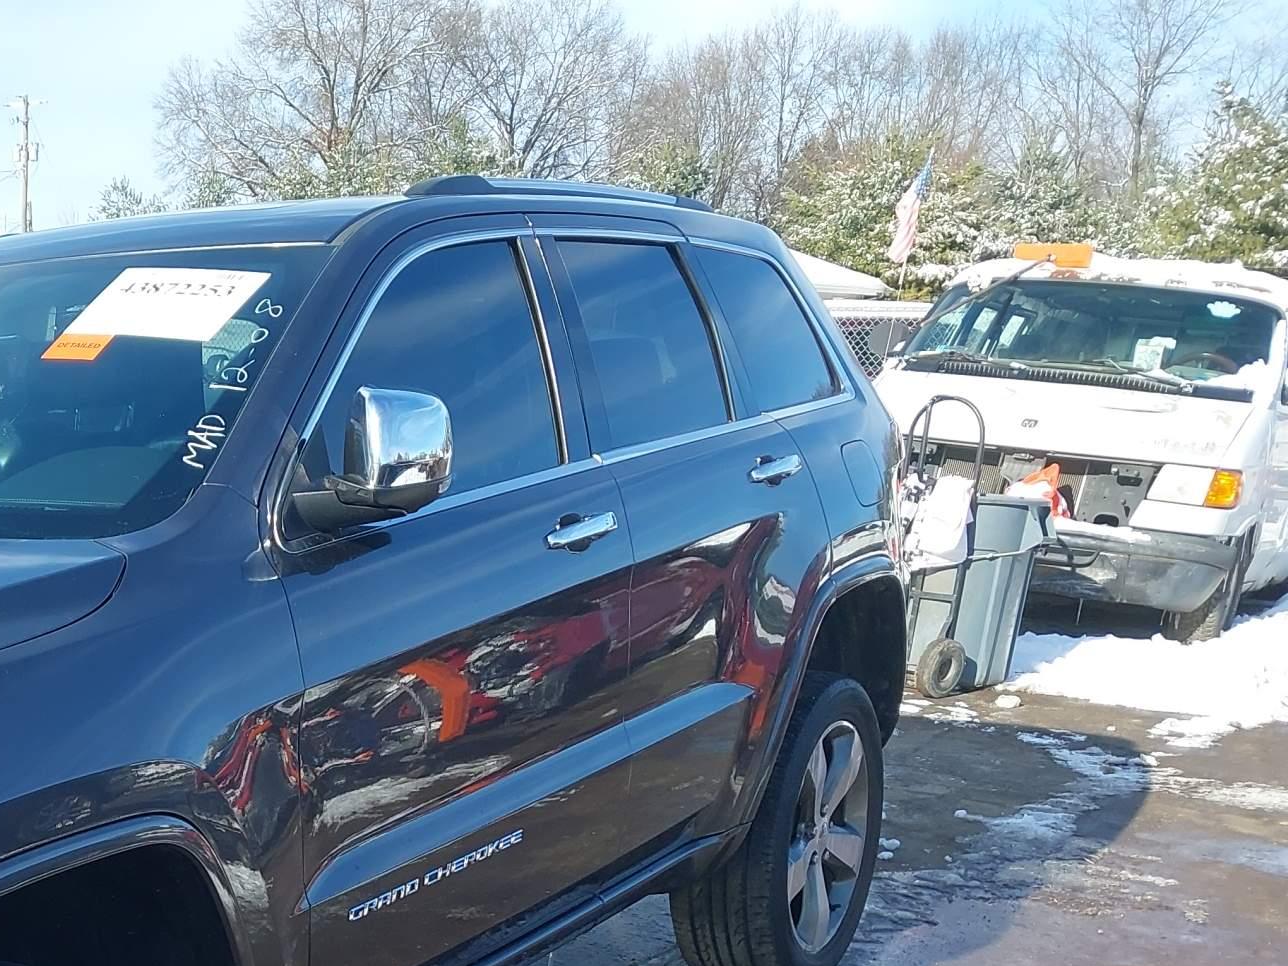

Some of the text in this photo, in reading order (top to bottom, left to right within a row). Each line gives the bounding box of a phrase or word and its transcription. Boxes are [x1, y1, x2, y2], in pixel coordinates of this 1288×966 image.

[120, 280, 238, 297] 43872253
[57, 341, 102, 350] DETAILED
[181, 413, 227, 469] MAD
[348, 829, 525, 921] GRAND CHEROKEE
